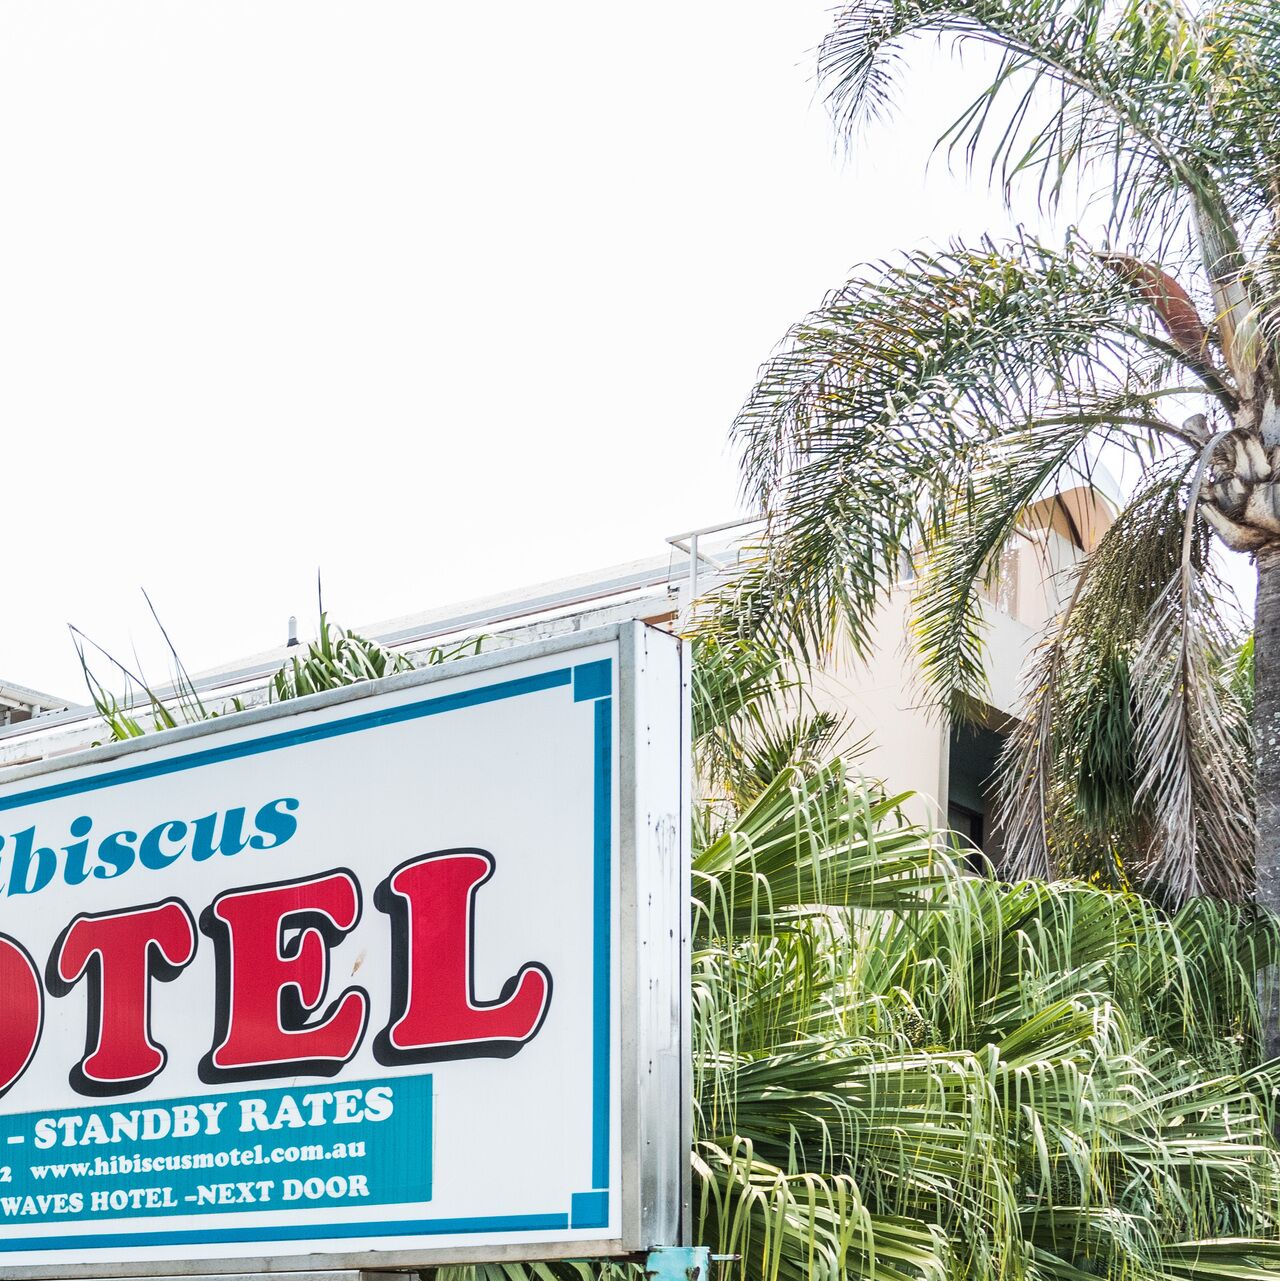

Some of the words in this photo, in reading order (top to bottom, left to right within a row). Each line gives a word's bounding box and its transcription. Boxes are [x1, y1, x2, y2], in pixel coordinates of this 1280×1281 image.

[34, 1101, 228, 1149] STANDBY
[238, 1086, 394, 1133] RATES
[29, 1141, 367, 1180] www.hibiscusmotel.com.au
[0, 1192, 84, 1217] WAVES
[90, 1187, 178, 1212] HOTEL
[282, 1174, 370, 1201] DOOR
